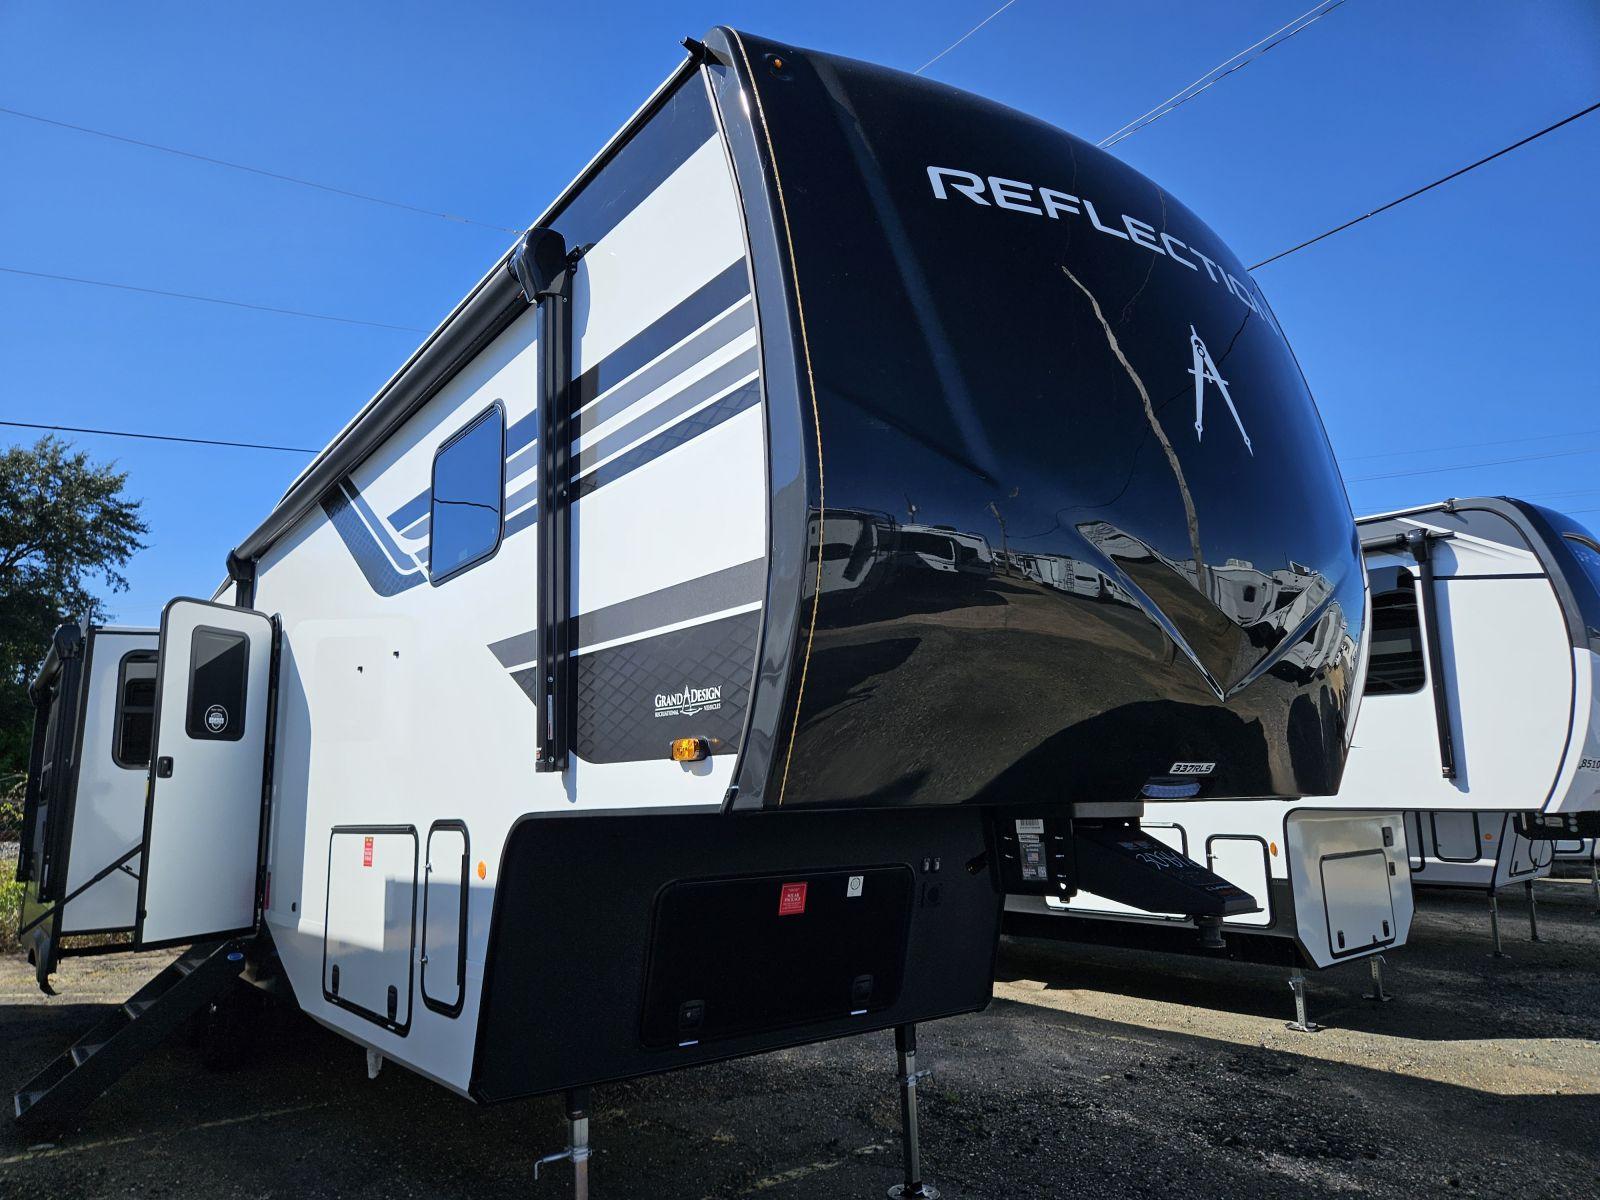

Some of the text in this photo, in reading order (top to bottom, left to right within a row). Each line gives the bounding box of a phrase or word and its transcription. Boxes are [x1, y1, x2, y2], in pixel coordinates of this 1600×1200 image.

[655, 686, 721, 708] GRAND DESIGN
[1171, 764, 1213, 774] 337RLS
